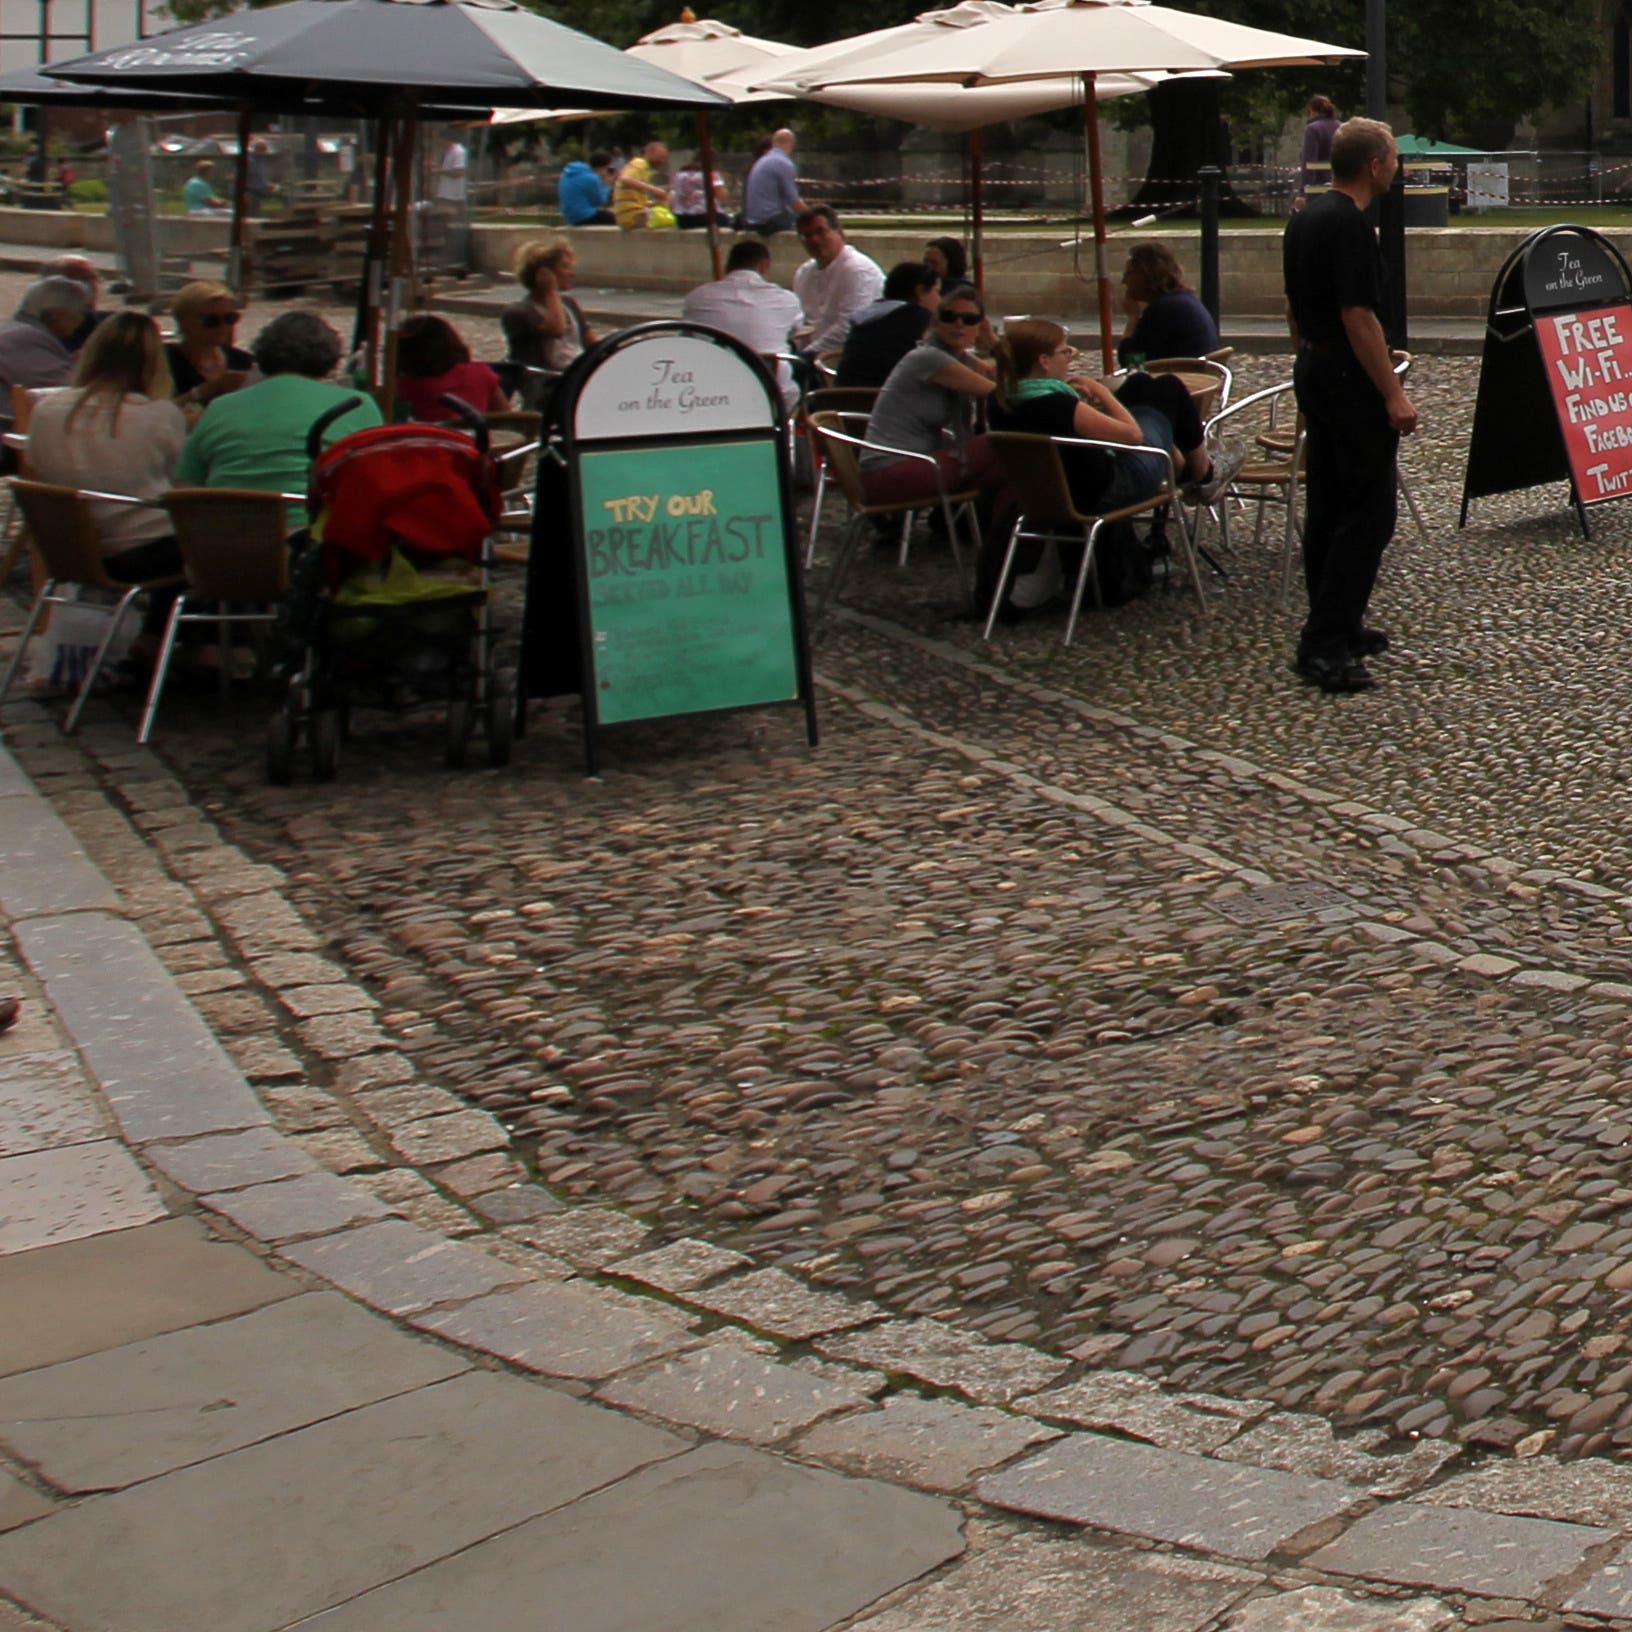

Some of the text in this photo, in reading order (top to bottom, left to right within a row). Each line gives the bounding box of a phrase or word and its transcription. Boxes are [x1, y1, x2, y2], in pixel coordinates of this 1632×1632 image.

[1556, 252, 1581, 271] Tea
[1545, 269, 1603, 291] on the Green
[1553, 314, 1624, 355] FREE
[651, 360, 694, 385] Tea
[618, 386, 730, 414] on the Green
[1565, 393, 1609, 423] FIND
[1608, 392, 1627, 412] US
[604, 489, 717, 522] TRY OUR
[587, 514, 773, 577] BREAKFAST
